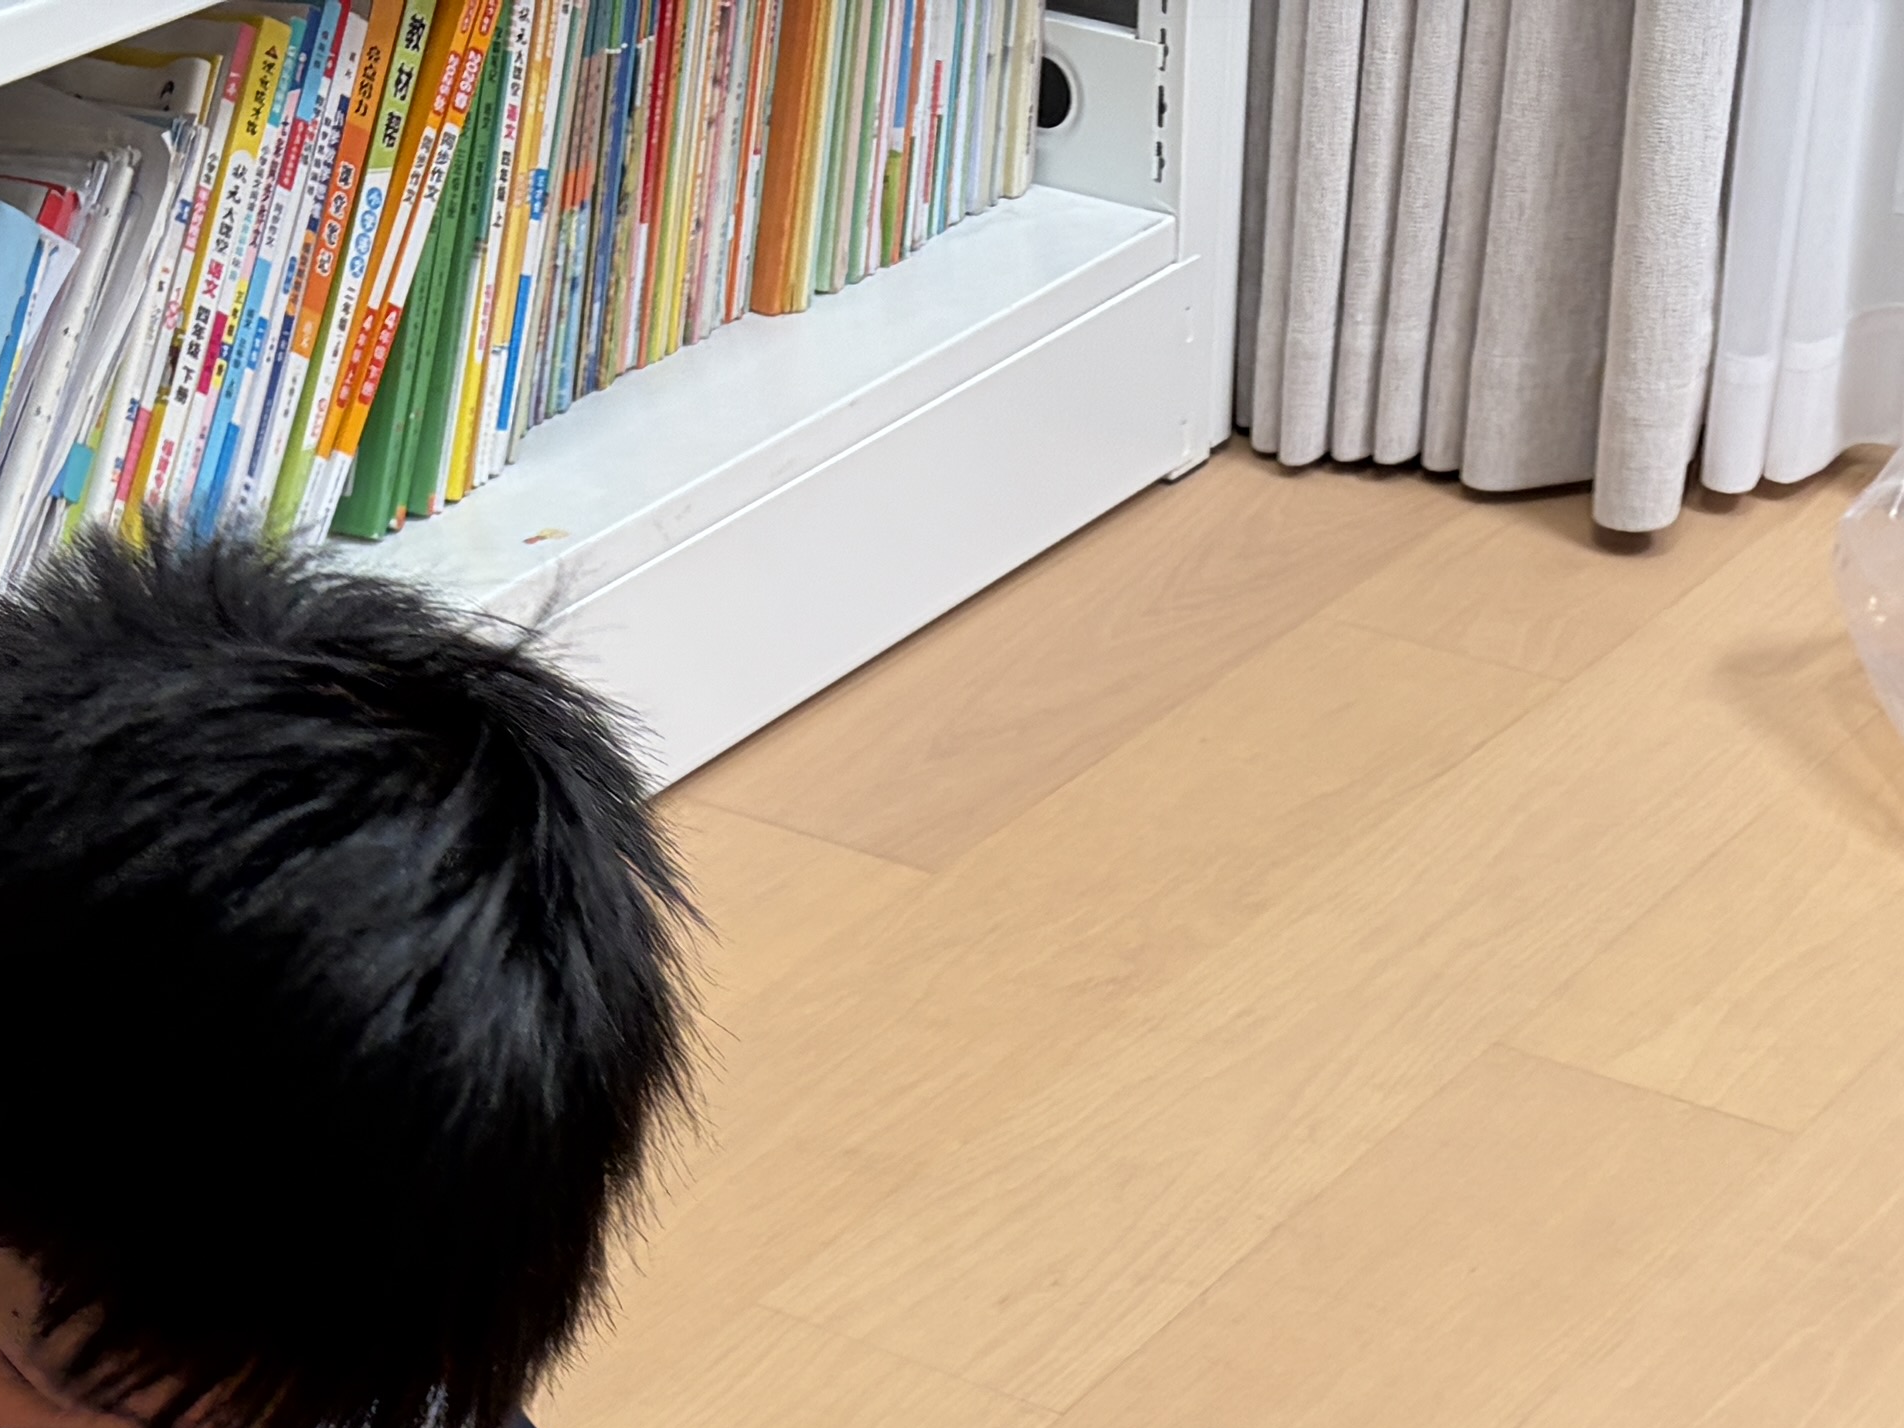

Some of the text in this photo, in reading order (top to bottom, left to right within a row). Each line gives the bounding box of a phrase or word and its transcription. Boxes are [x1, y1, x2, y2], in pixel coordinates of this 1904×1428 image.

[382, 13, 427, 148] 教材帮
[402, 133, 435, 205] 同步作文
[423, 130, 459, 203] 同步作文
[173, 163, 249, 406] 状元大课堂 语文 四年级 下册
